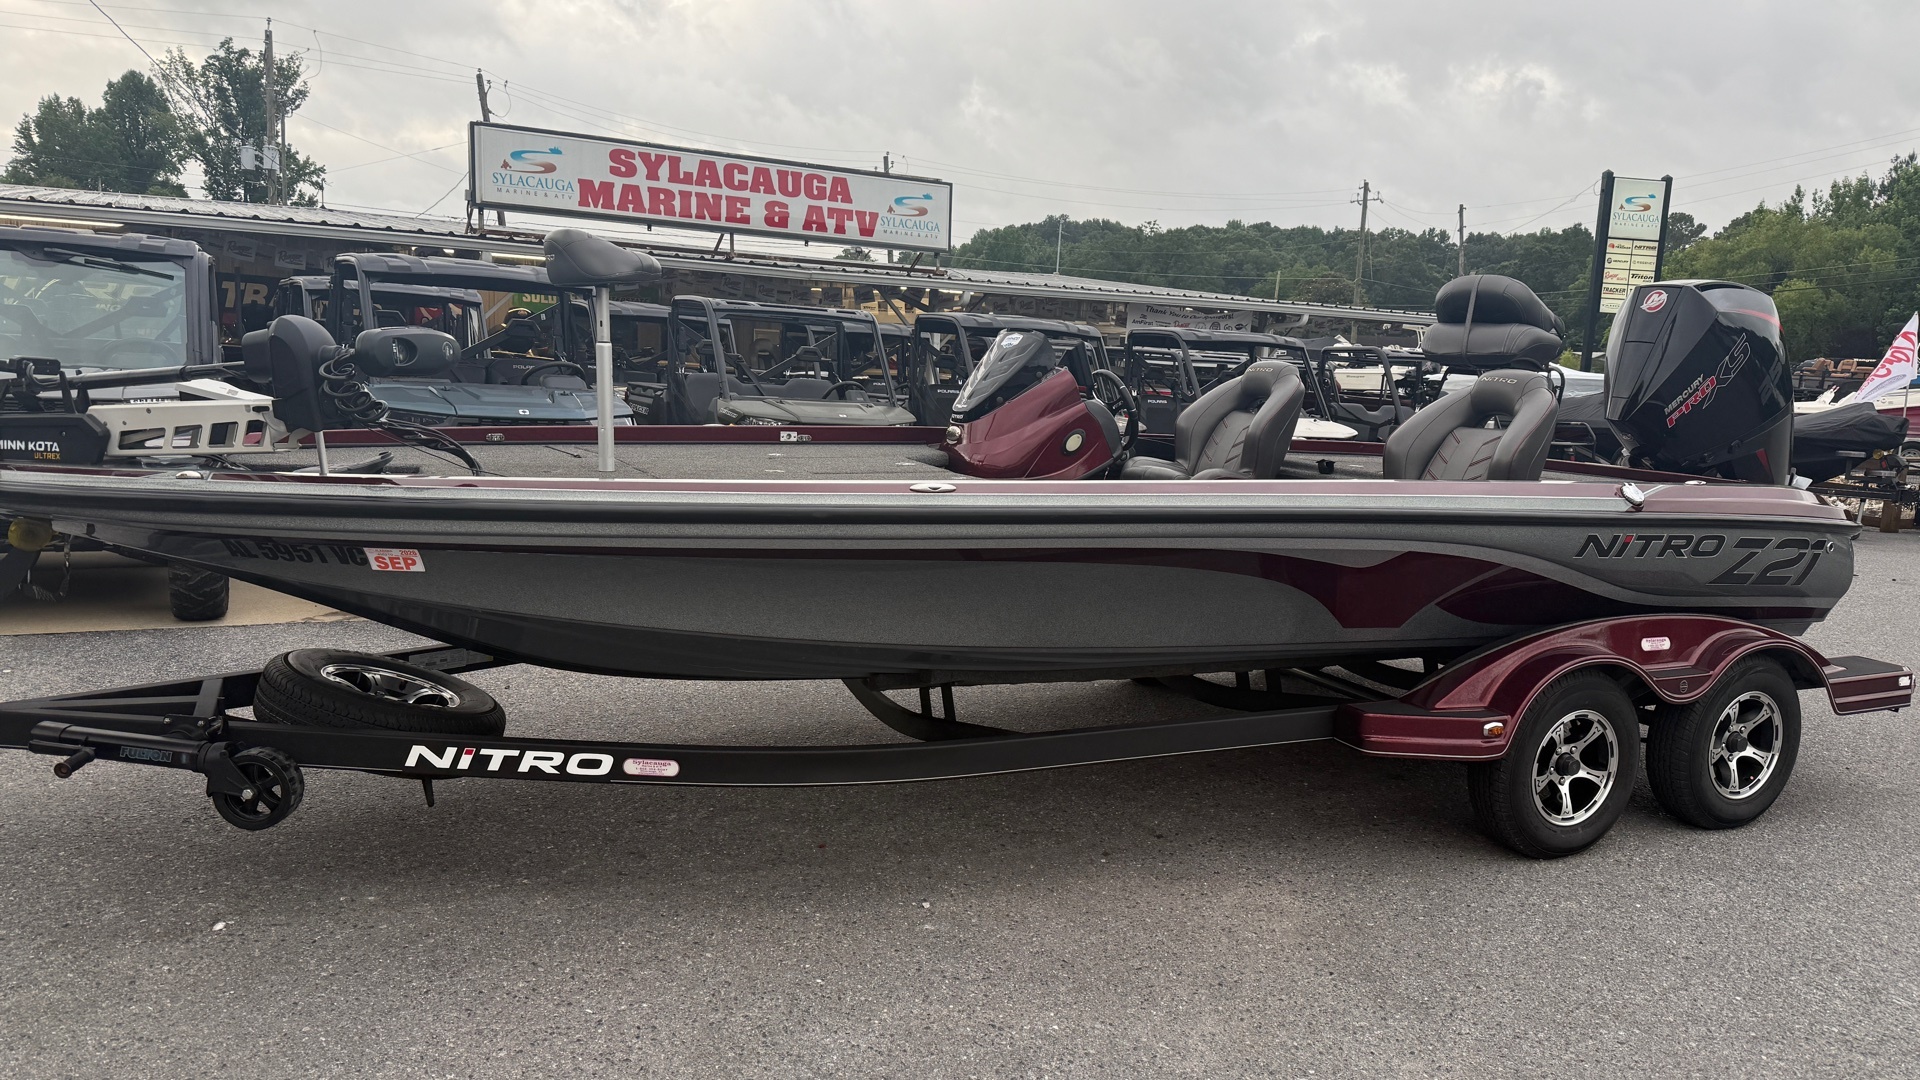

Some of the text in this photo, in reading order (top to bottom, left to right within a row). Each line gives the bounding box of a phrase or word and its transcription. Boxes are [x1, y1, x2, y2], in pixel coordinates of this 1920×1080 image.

[492, 172, 575, 192] SYLACAUGA
[608, 148, 853, 204] SYLACAUGA
[496, 187, 538, 196] MARINE
[578, 178, 880, 238] MARINE & ATV
[880, 215, 941, 232] SYLACAUGA
[1612, 212, 1660, 223] SYLACAUGA
[883, 229, 914, 237] MARINE
[1145, 304, 1168, 315] Thank
[1169, 310, 1181, 318] You
[1664, 373, 1704, 415] MERCURY
[28, 441, 60, 452] KOTA
[34, 452, 61, 460] ULTREX
[221, 540, 370, 567] AL 5951 VC
[374, 555, 417, 570] SEP
[120, 745, 173, 763] FULTON
